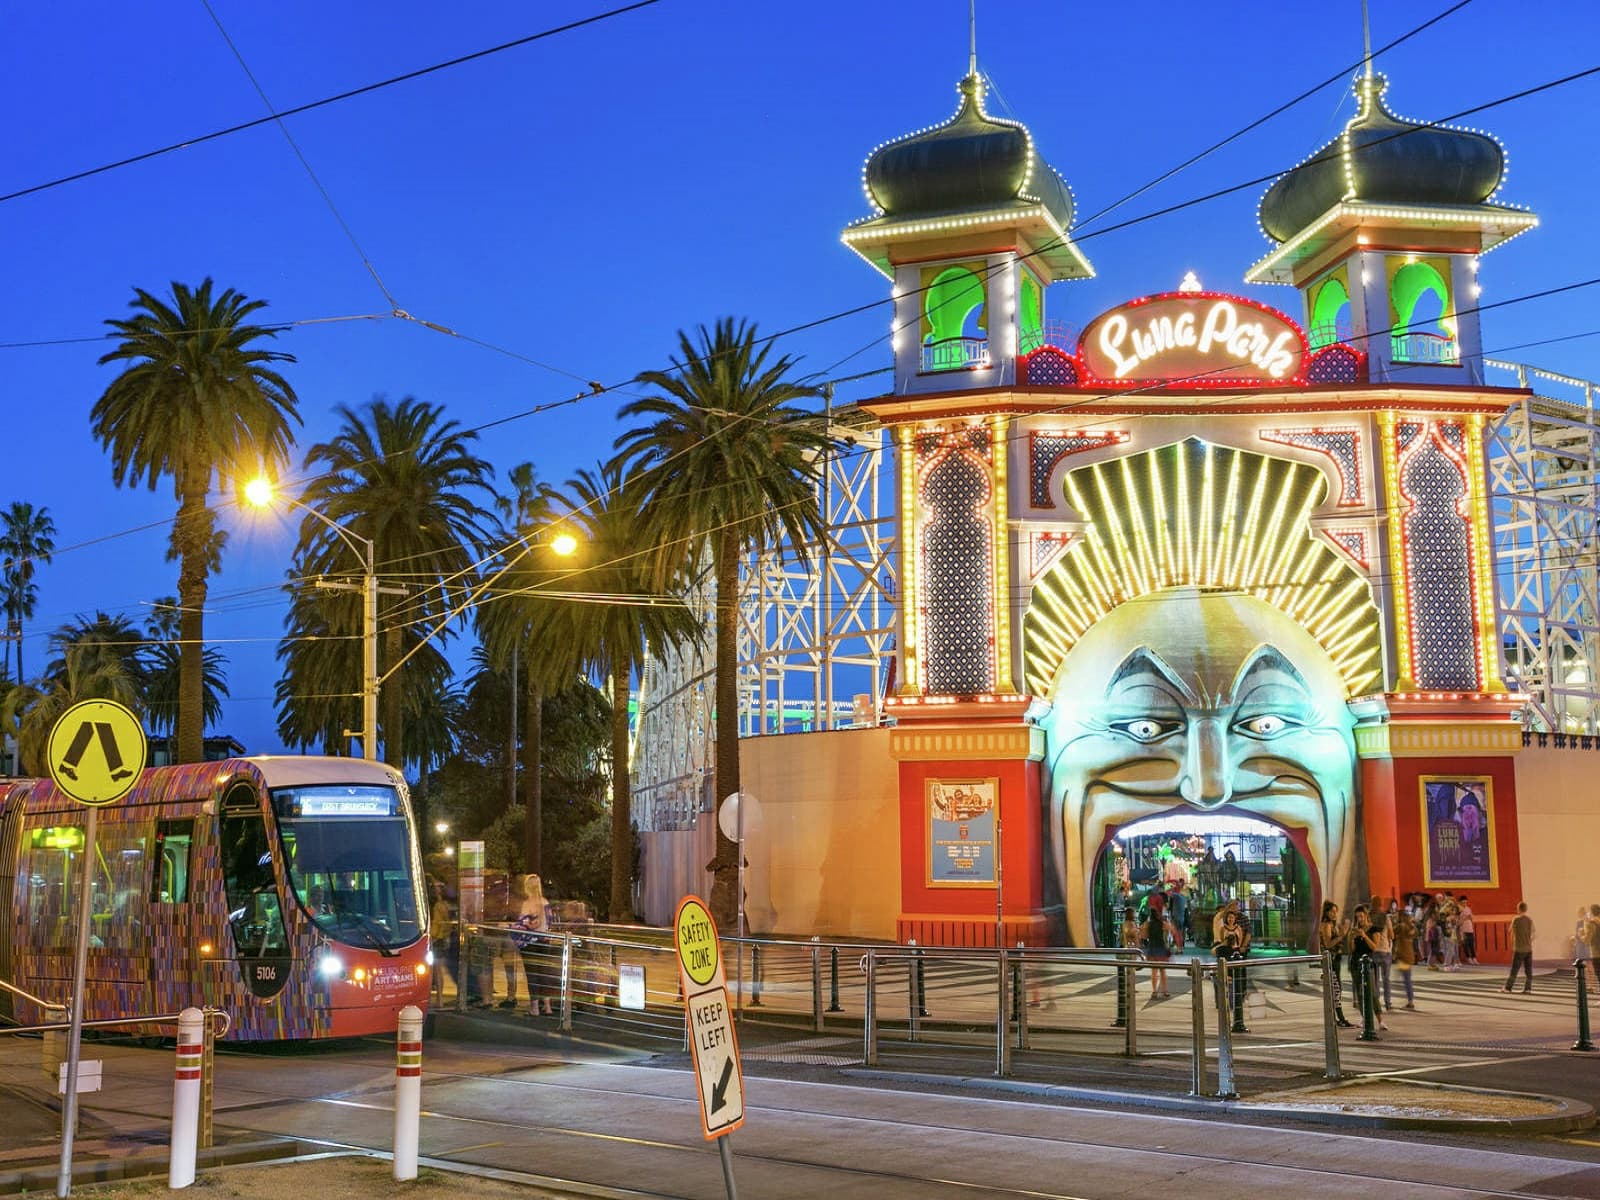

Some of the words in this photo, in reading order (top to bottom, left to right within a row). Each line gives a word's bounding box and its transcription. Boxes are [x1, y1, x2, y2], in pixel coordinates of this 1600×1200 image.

[1099, 314, 1197, 378] Luna
[1198, 301, 1294, 378] Park
[1249, 843, 1272, 854] ONE
[681, 921, 710, 945] SAFETY
[690, 947, 712, 970] ZONE
[257, 966, 276, 980] 5106
[374, 976, 390, 985] ART
[696, 1002, 723, 1026] KEEP
[701, 1026, 727, 1051] LEFT
